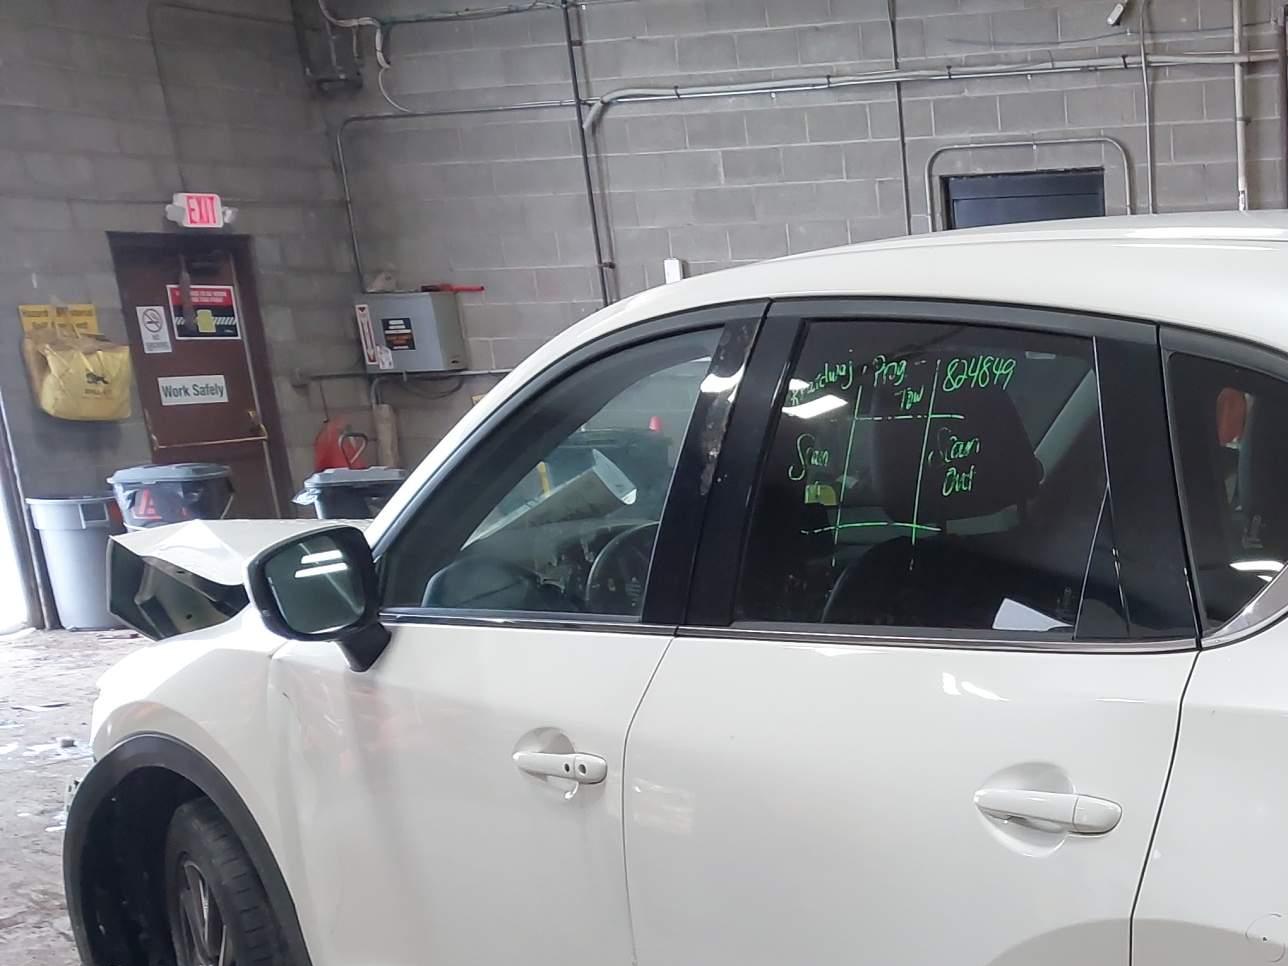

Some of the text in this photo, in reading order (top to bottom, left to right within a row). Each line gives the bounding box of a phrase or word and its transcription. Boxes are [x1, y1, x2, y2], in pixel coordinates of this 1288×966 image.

[186, 195, 217, 225] EXIT
[942, 355, 1016, 391] 824849
[161, 383, 224, 398] Work Safely
